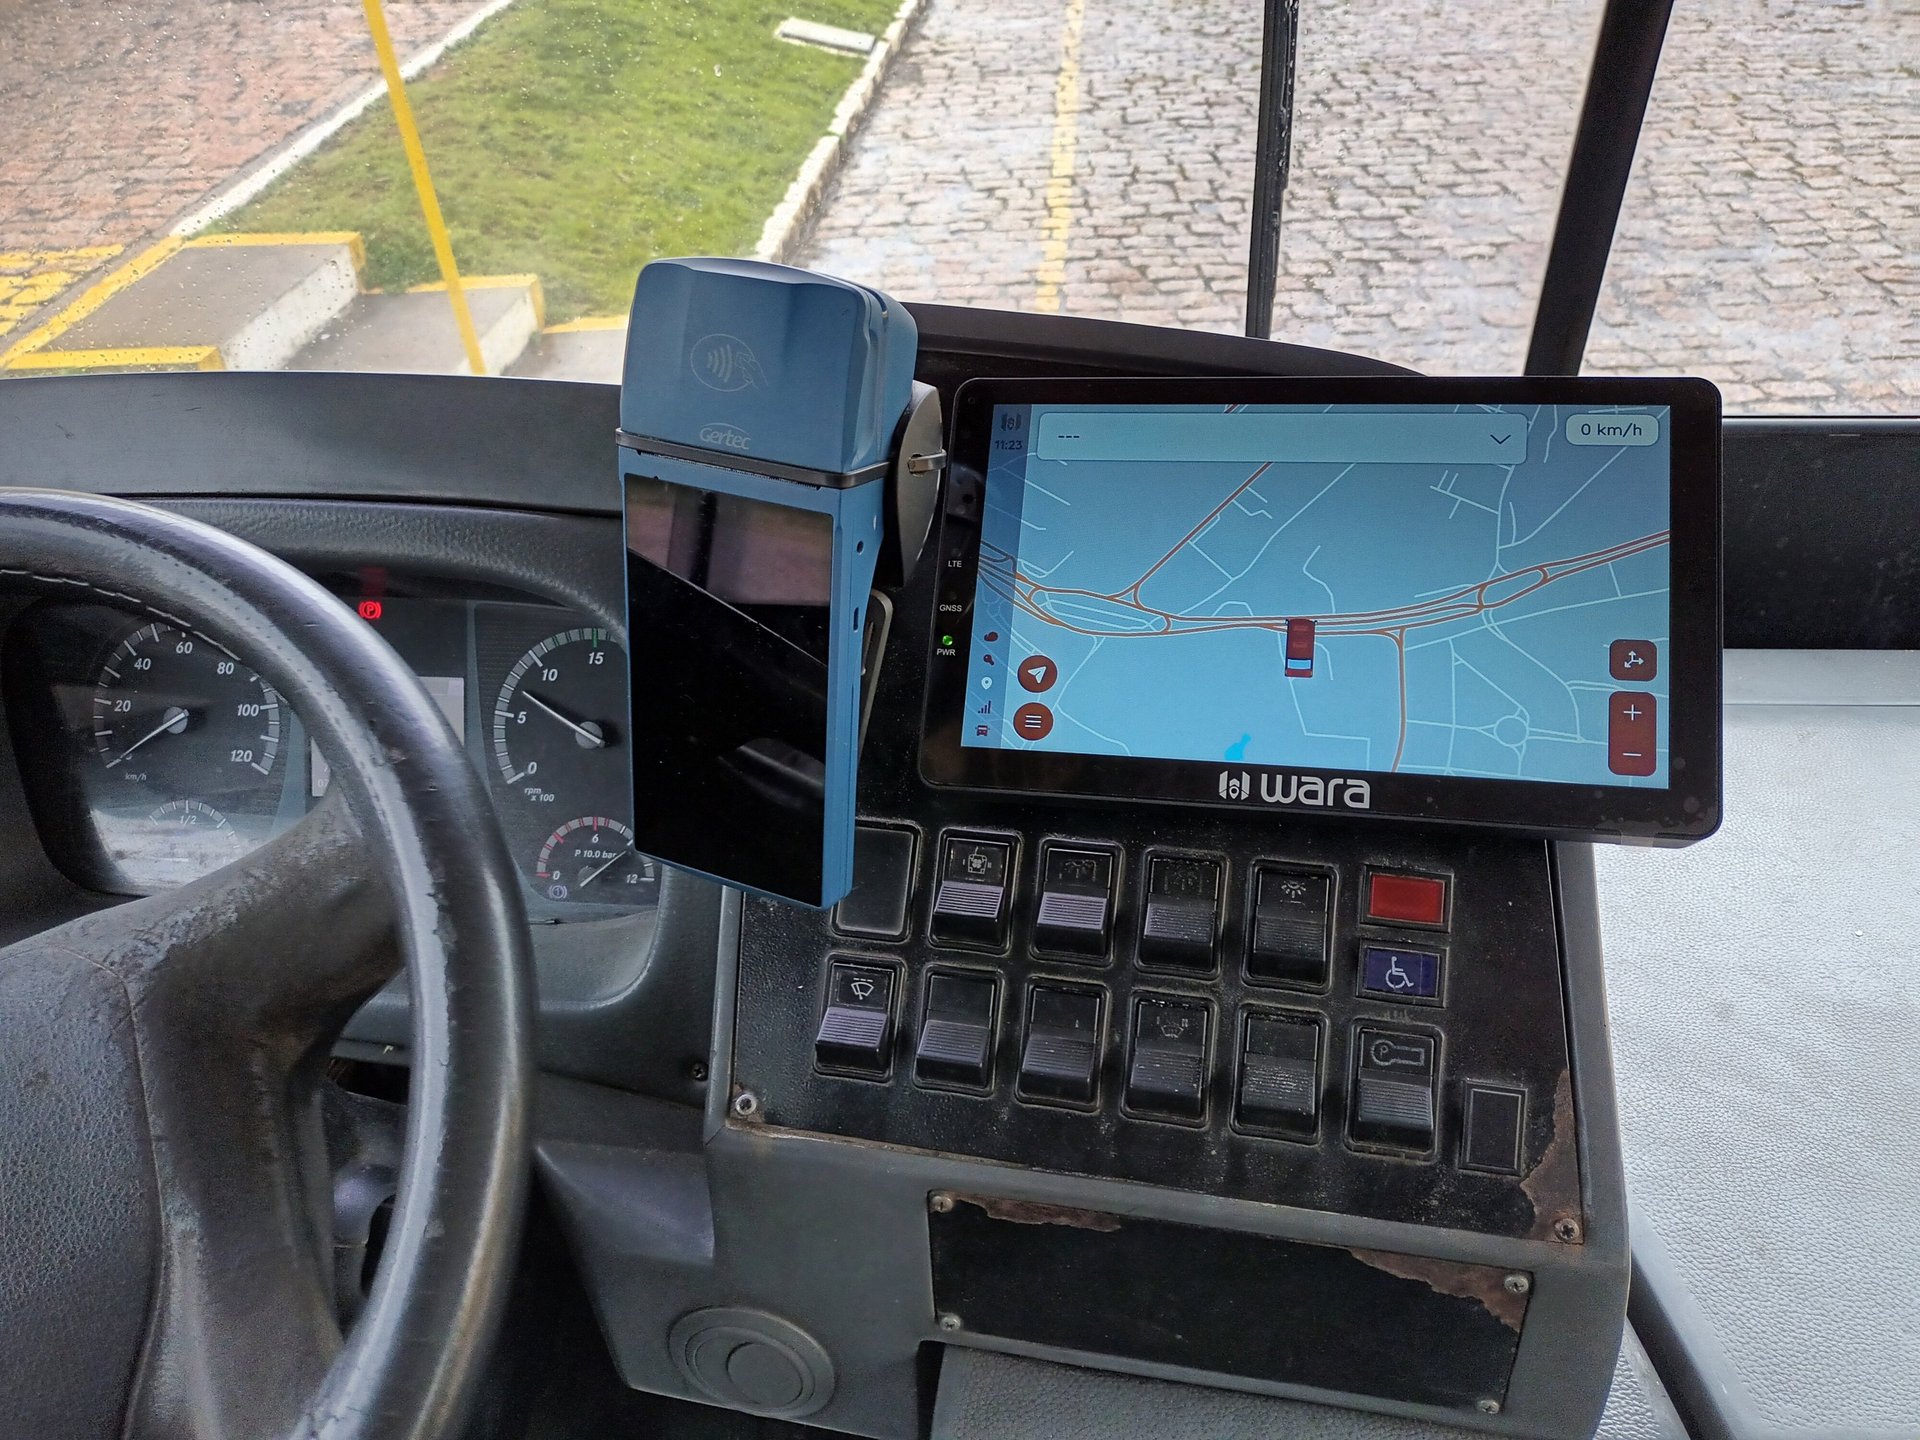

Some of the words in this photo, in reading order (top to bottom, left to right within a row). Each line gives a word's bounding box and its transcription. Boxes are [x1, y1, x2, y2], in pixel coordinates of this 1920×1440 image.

[1581, 423, 1591, 436] 0
[1597, 422, 1642, 438] km/h
[700, 427, 752, 450] Gertec
[995, 440, 1023, 450] 11:23
[948, 560, 962, 568] LTE
[939, 604, 962, 612] GNSS
[176, 641, 193, 654] 60
[936, 648, 956, 657] PWR
[134, 658, 151, 671] 40
[588, 652, 604, 665] 15
[217, 662, 234, 675] 80
[541, 669, 558, 682] 10
[114, 699, 131, 713] 20
[237, 704, 259, 717] 100
[517, 712, 526, 724] 5
[231, 750, 252, 763] 120
[527, 762, 537, 775] 0
[125, 771, 147, 782] km/h
[1261, 773, 1370, 808] wara
[540, 794, 555, 802] 100
[180, 815, 197, 827] 1/2
[592, 834, 599, 843] 6
[575, 849, 581, 857] P
[583, 850, 600, 858] 10.0
[552, 871, 560, 880] 0
[626, 874, 638, 884] 12
